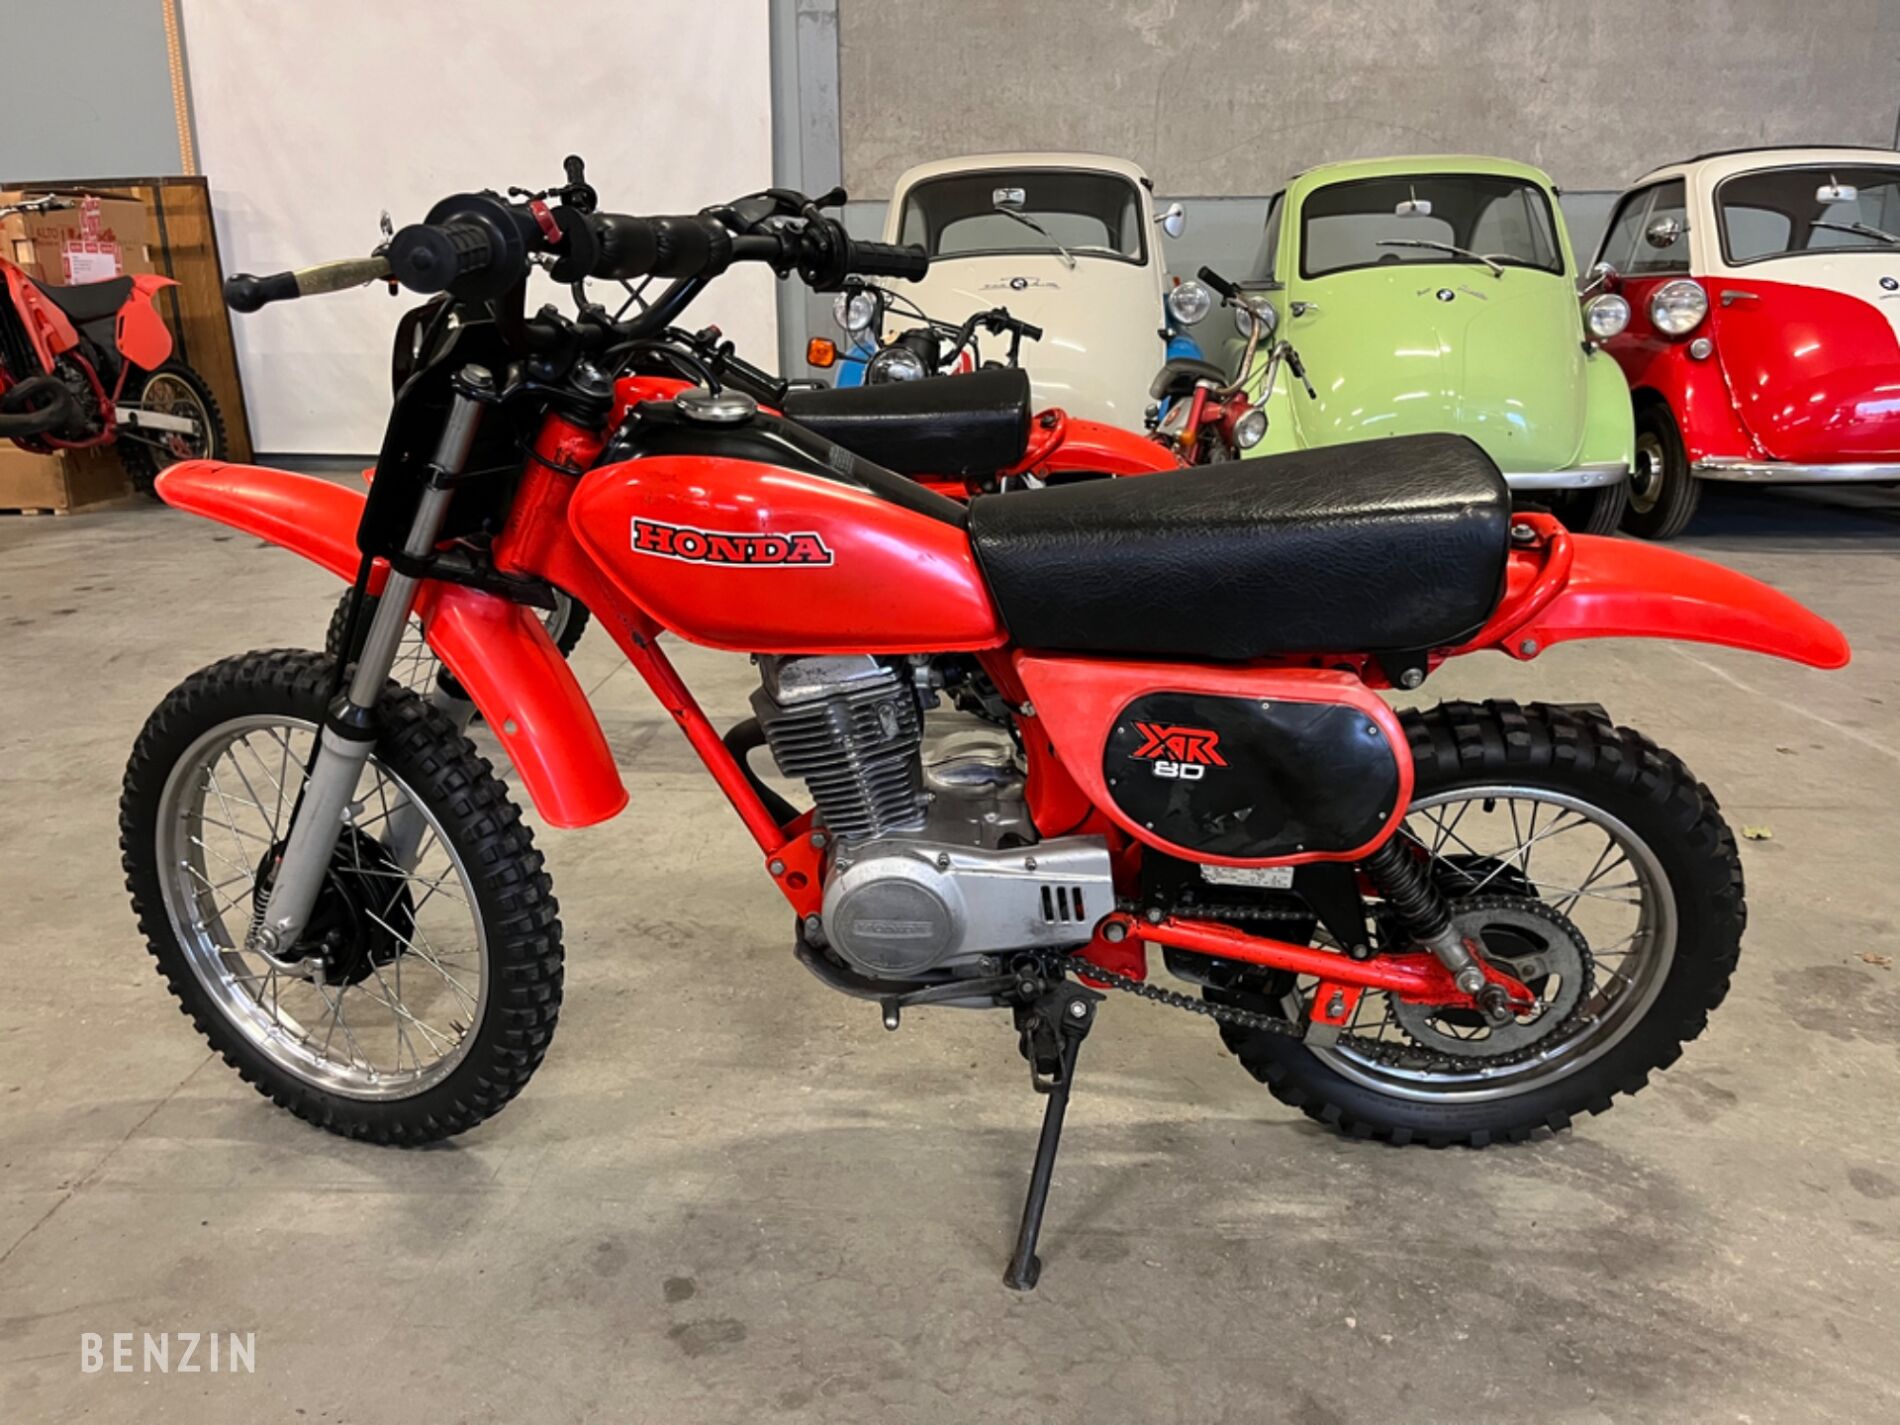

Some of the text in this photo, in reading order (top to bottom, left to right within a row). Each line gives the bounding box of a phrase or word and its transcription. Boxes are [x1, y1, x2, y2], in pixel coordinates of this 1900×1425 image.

[633, 519, 833, 565] HONDA
[1132, 722, 1229, 767] XR
[1154, 760, 1205, 780] 80
